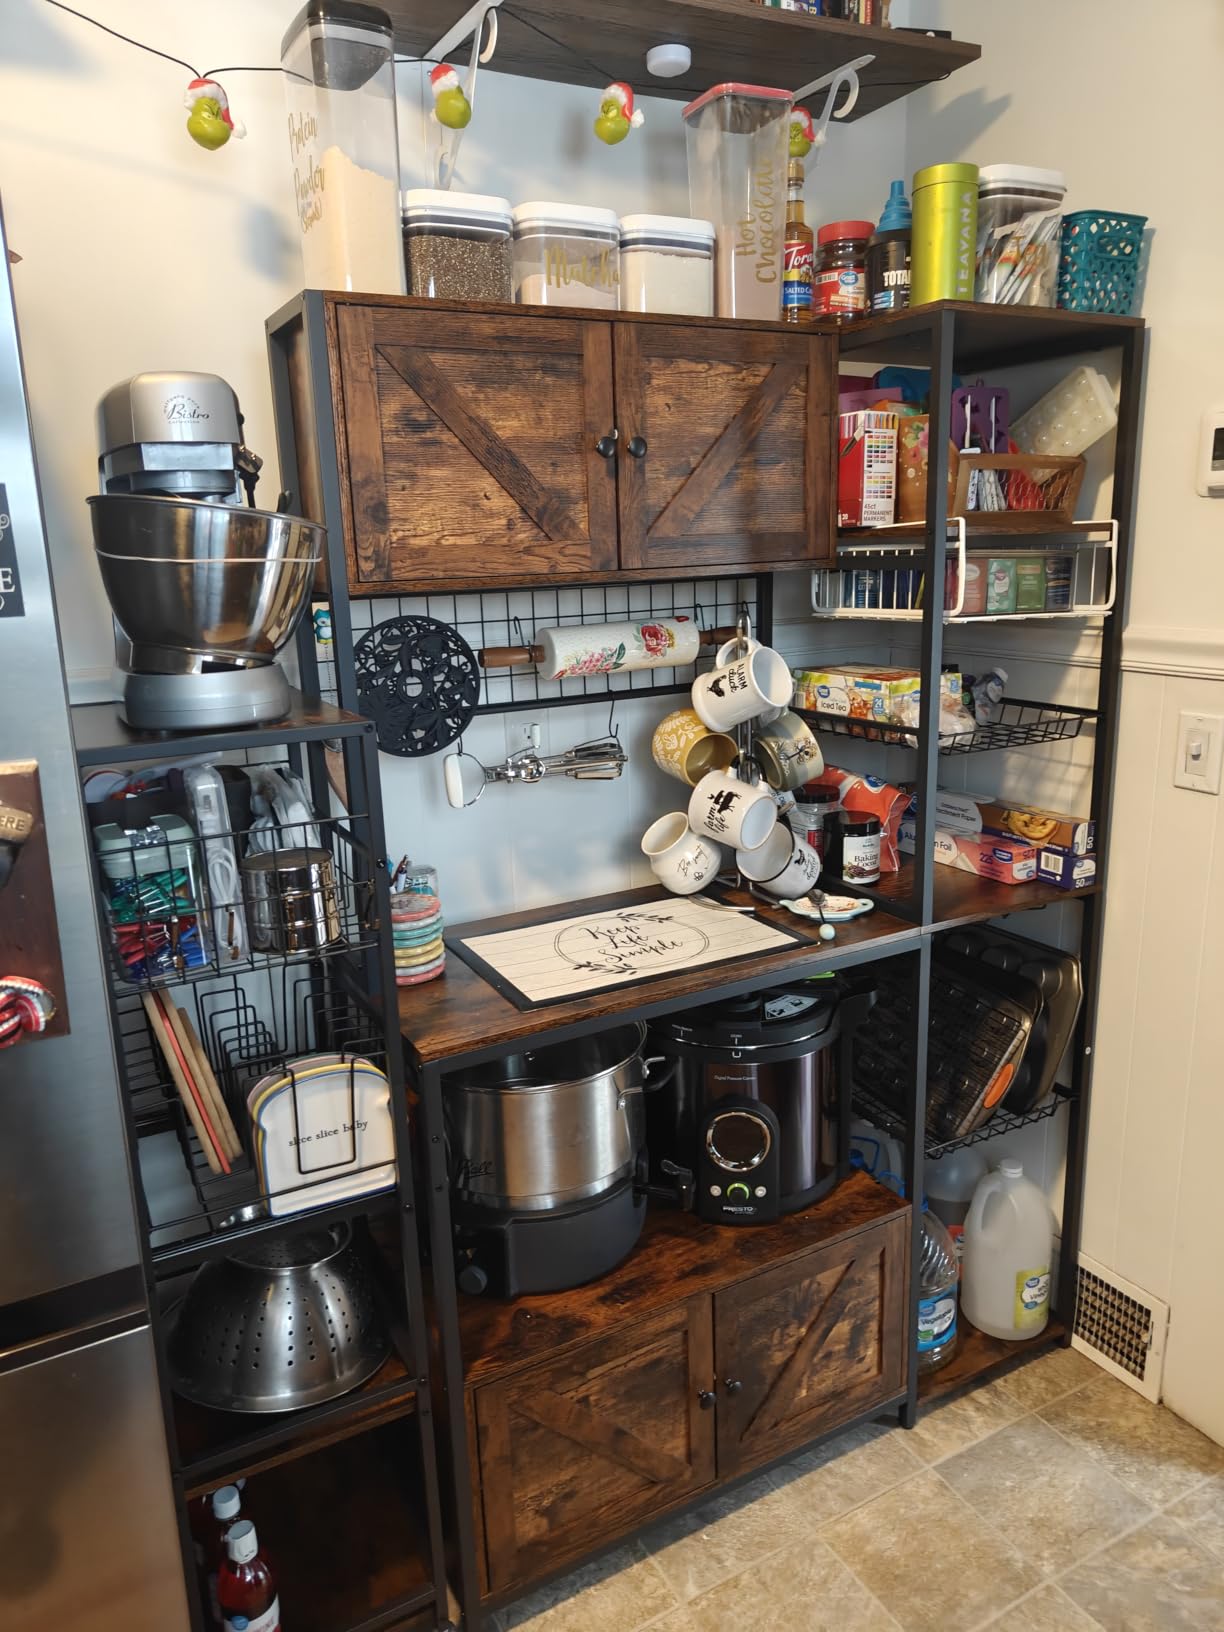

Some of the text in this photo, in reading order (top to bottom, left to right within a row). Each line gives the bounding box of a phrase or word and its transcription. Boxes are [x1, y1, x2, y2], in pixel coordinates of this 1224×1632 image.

[288, 111, 318, 162] Protein
[753, 157, 777, 284] Chocolate
[736, 212, 757, 258] Hot
[957, 192, 972, 295] TEAVANA
[785, 286, 805, 295] SALTED
[167, 403, 210, 420] Bistro
[737, 663, 749, 690] ALARM
[821, 701, 847, 712] Iced Tea
[703, 804, 720, 834] farm
[714, 814, 730, 833] life
[940, 841, 952, 852] Foil
[1086, 836, 1094, 849] 50
[1075, 878, 1086, 889] 50
[579, 925, 640, 940] Keep
[609, 934, 649, 950] Life
[597, 940, 684, 963] Simple
[315, 1129, 339, 1140] slice
[723, 1205, 754, 1213] PRESTO
